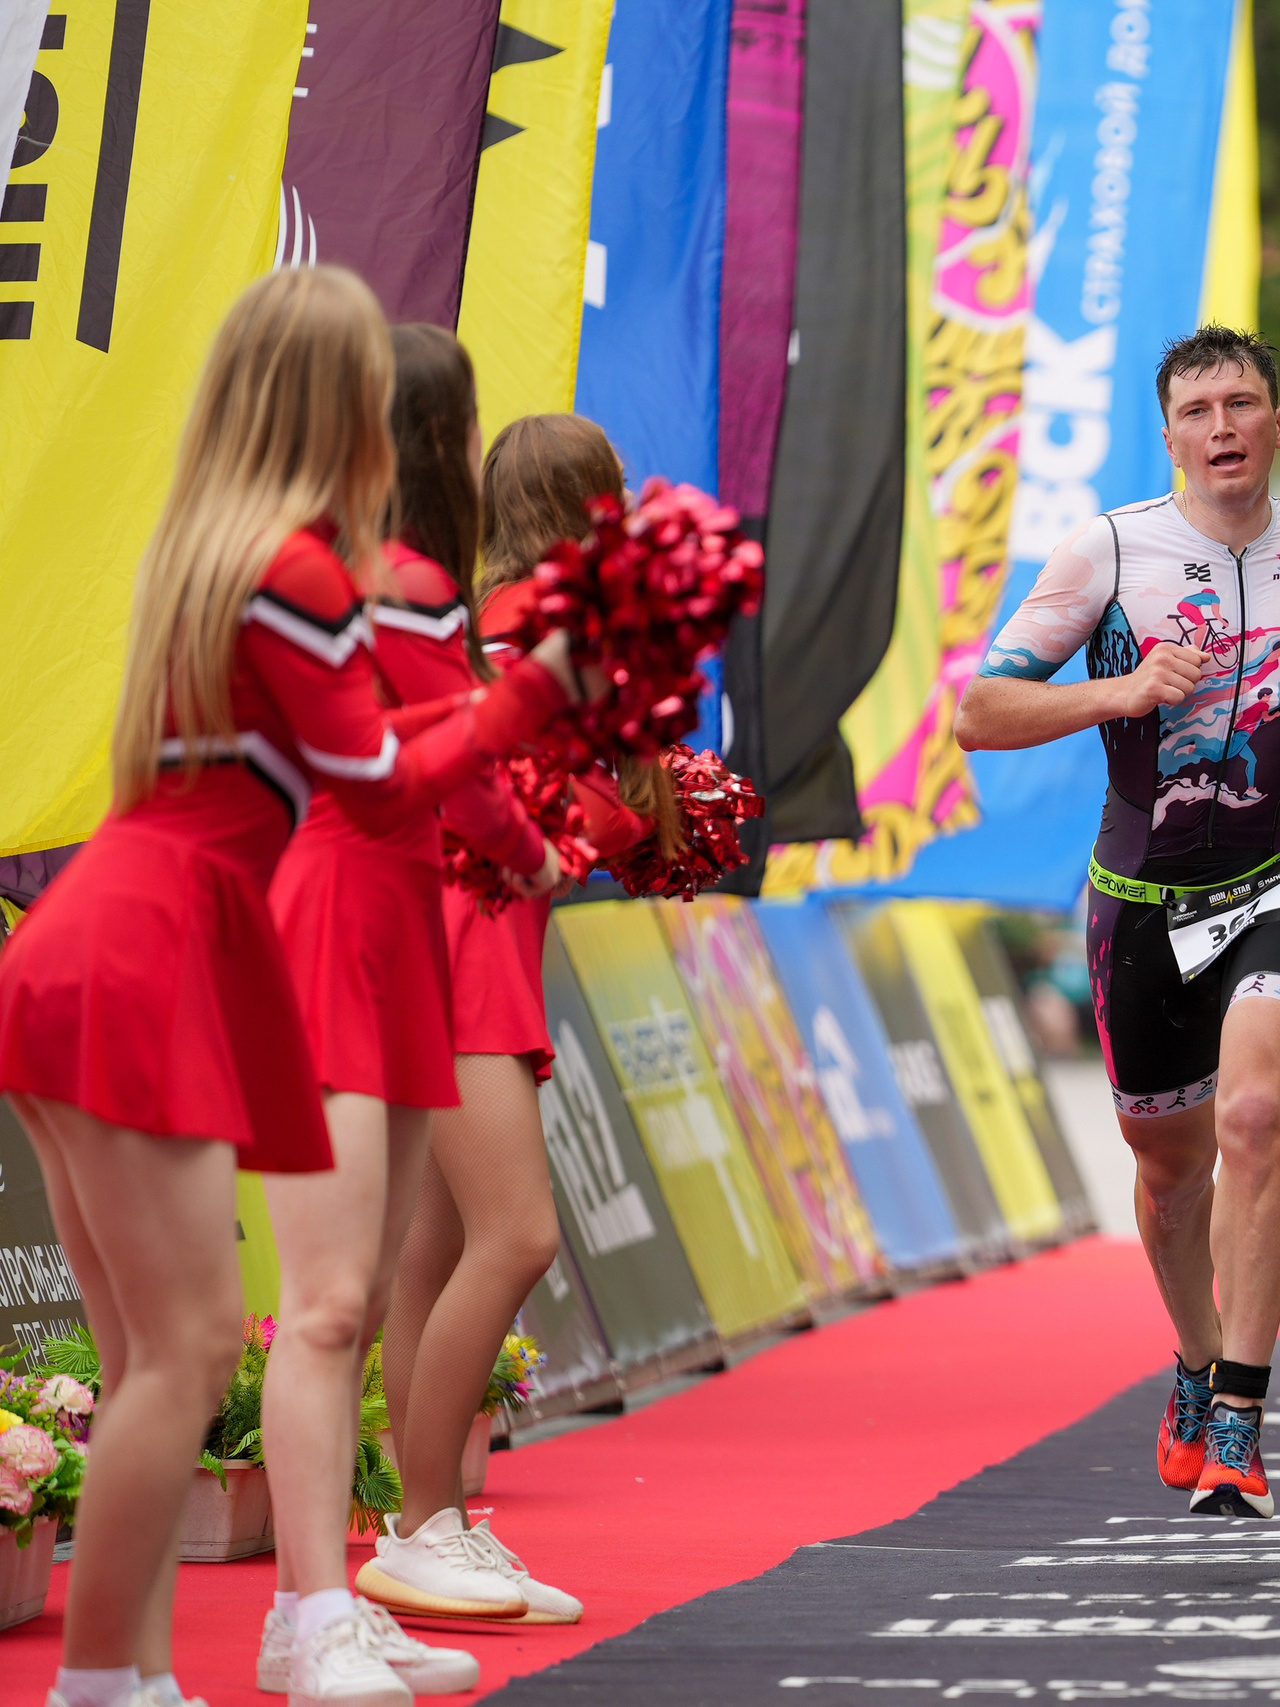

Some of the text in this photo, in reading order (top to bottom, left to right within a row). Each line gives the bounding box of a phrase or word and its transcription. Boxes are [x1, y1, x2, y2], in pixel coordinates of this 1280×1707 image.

[1008, 323, 1118, 563] ВСК
[1208, 883, 1251, 904] IRON STAR
[886, 1615, 1275, 1632] IRON
